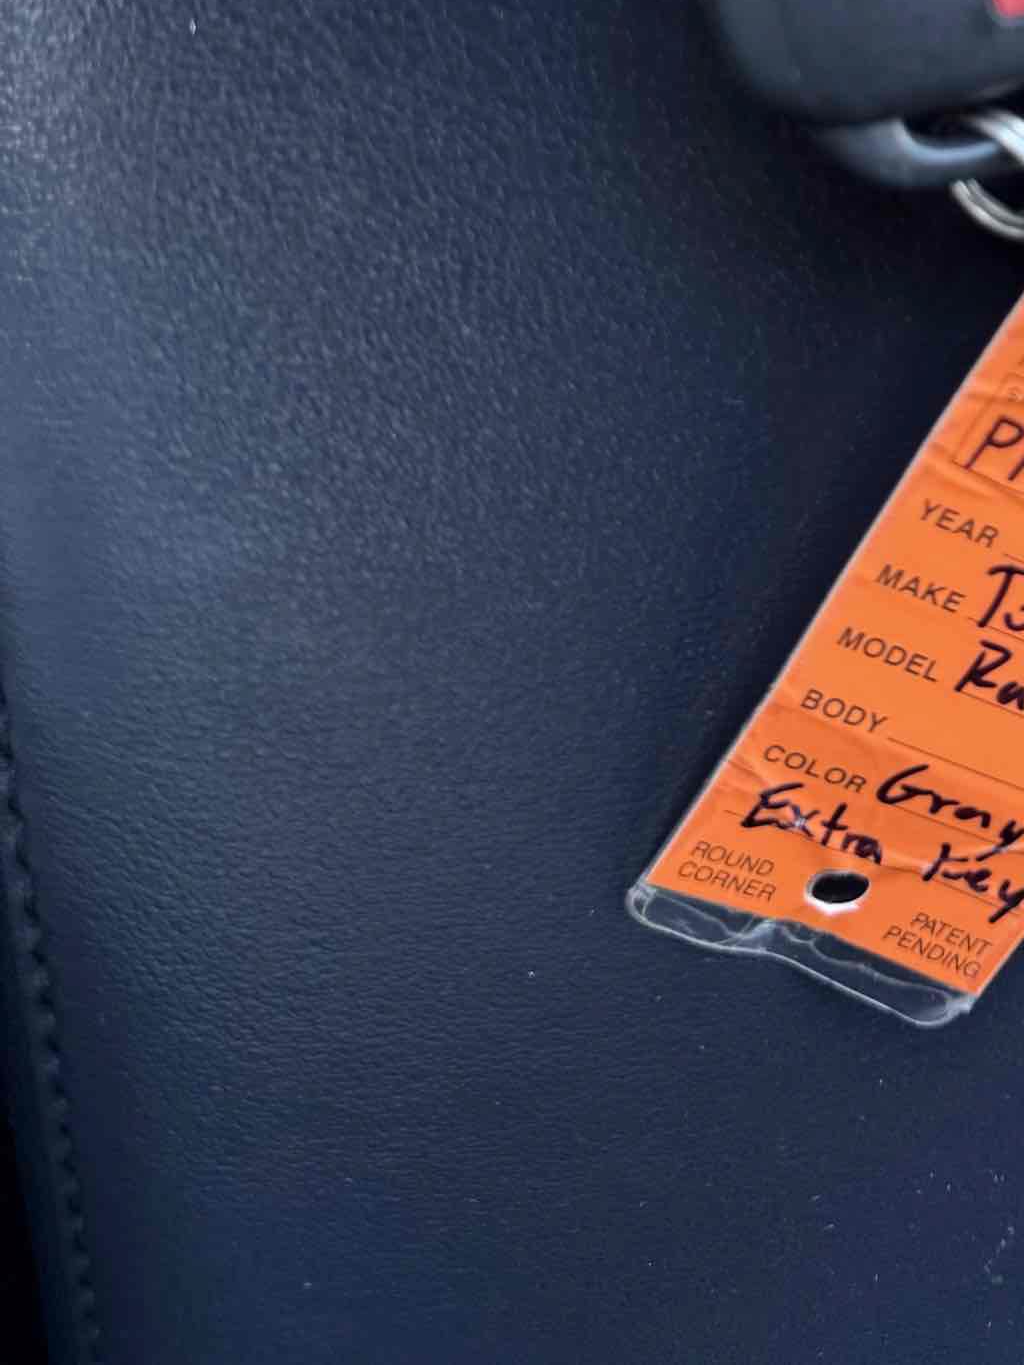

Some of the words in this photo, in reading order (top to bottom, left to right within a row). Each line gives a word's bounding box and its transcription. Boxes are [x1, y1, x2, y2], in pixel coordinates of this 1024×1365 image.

[919, 499, 999, 549] YEAR
[876, 564, 966, 614] MAKE
[837, 627, 938, 684] MODEL
[800, 688, 889, 733] BODY
[763, 745, 868, 794] COLOR
[740, 782, 883, 866] Extra
[677, 860, 777, 902] CORNER
[690, 840, 775, 877] ROUND
[882, 925, 983, 979] PENDING
[911, 912, 993, 956] PATENT
